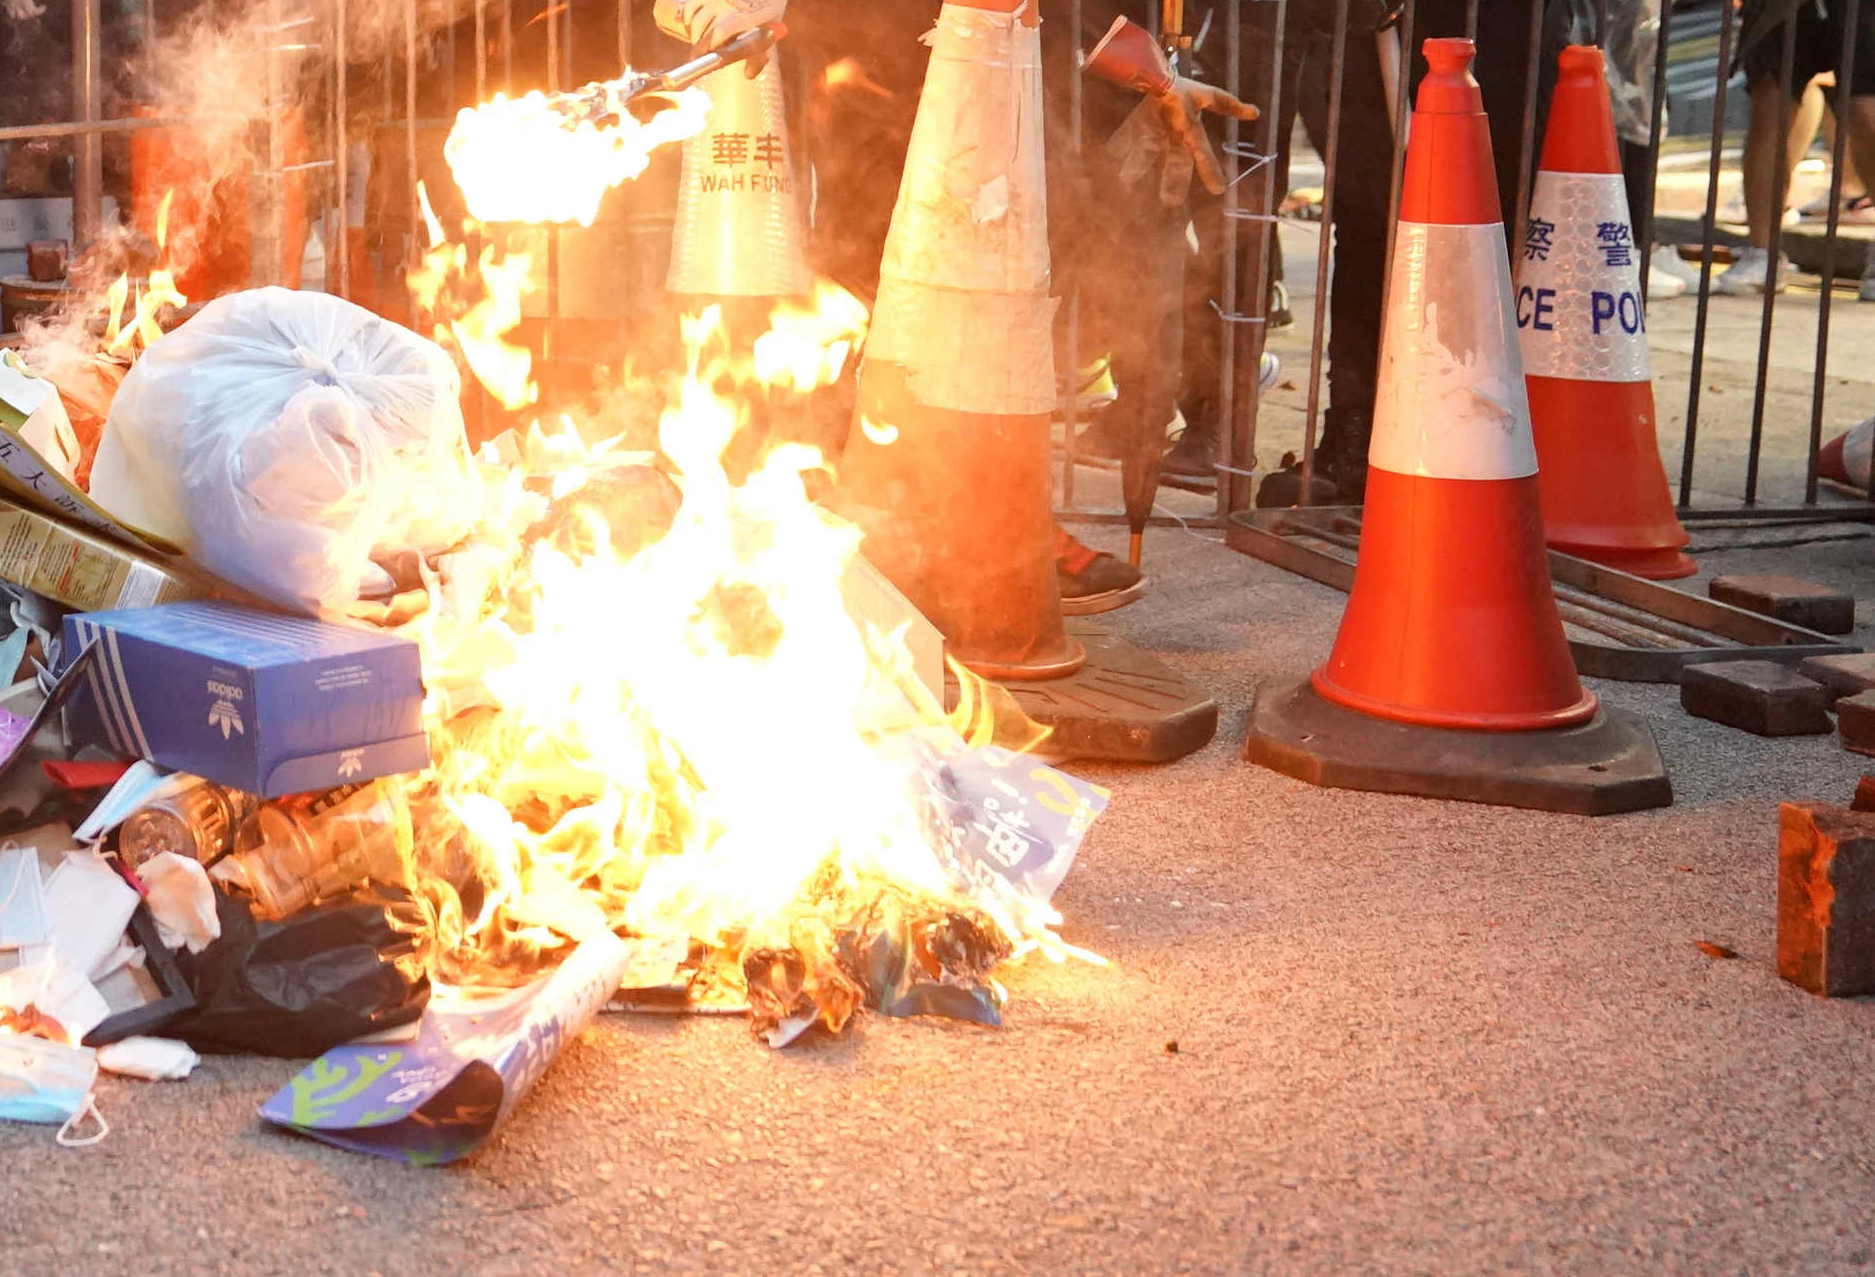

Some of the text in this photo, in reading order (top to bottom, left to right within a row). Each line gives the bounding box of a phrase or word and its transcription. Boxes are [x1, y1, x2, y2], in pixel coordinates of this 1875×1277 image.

[701, 172, 745, 193] WAH
[1524, 217, 1632, 267] 察 警
[206, 679, 244, 702] adidas
